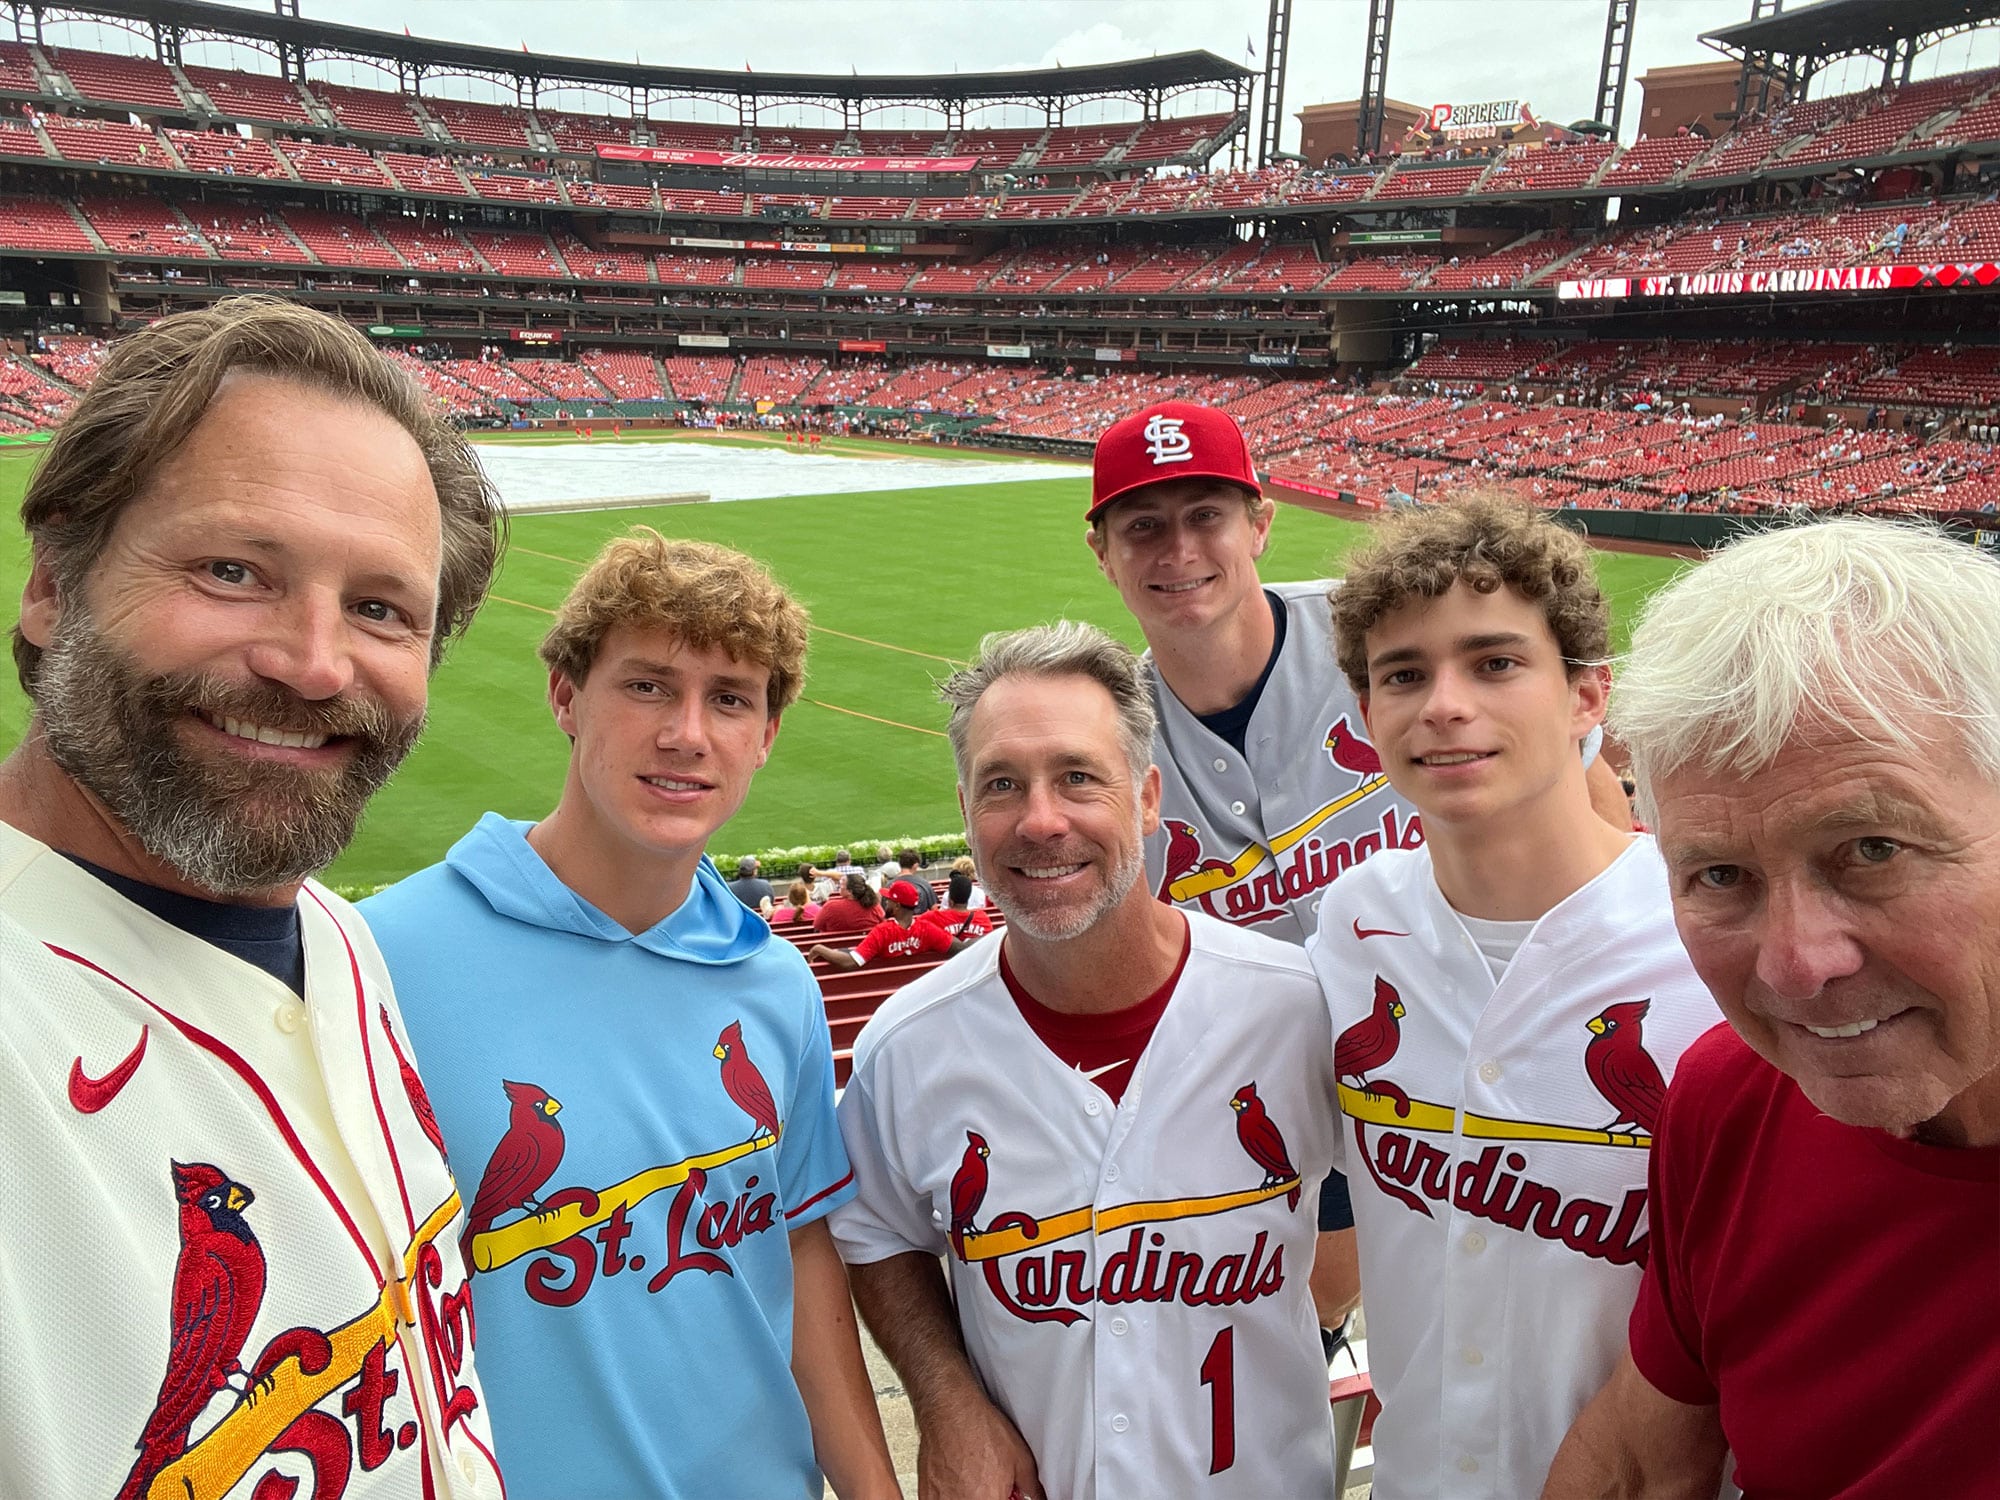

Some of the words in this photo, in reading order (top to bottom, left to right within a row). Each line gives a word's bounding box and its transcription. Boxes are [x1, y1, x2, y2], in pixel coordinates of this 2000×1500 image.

[1430, 100, 1519, 131] PERFICIENT
[1447, 124, 1497, 141] PERCH
[719, 151, 866, 170] Budweiser
[1644, 277, 1674, 297] ST.
[1680, 273, 1745, 295] LOUIS
[1750, 266, 1893, 293] CARDINALS
[519, 331, 553, 340] EQUIFAX
[1198, 808, 1426, 926] Cardinals
[1354, 1079, 1650, 1271] Cardinal
[525, 1187, 646, 1307] St.
[982, 1211, 1286, 1328] Cardinals
[1200, 1325, 1235, 1476] 1
